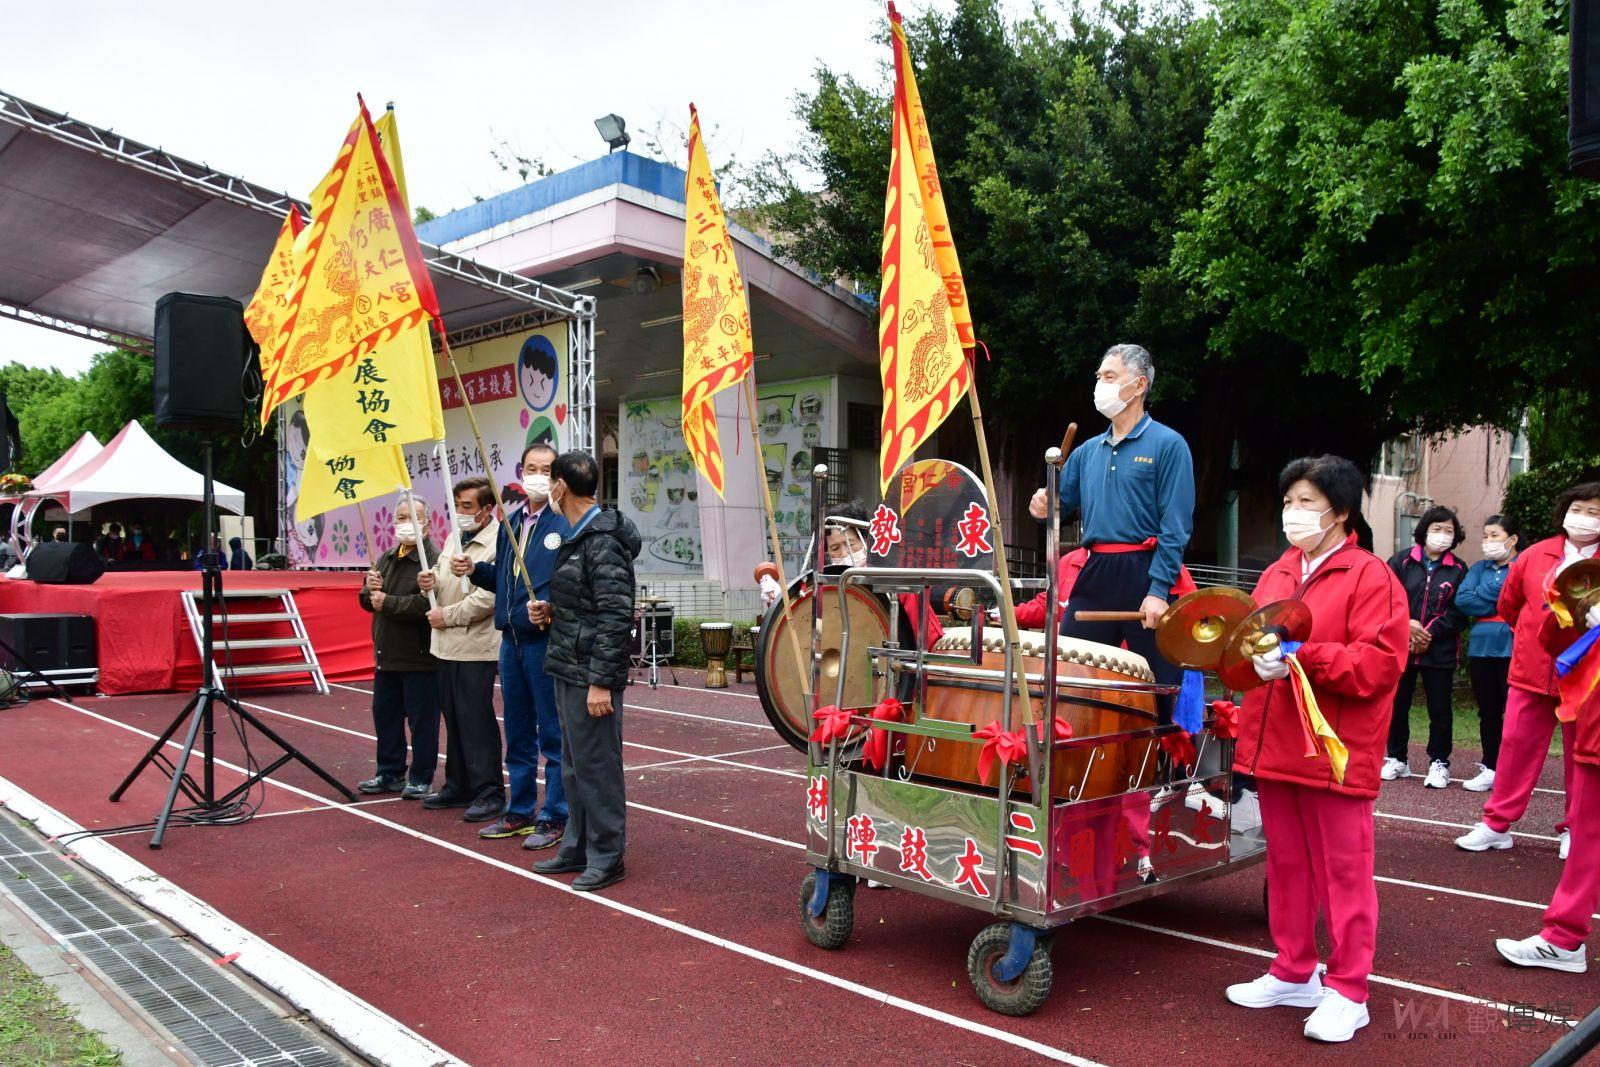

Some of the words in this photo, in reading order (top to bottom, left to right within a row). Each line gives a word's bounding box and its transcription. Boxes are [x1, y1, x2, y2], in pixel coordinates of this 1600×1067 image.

[368, 207, 411, 303] 廣仁宮
[353, 358, 397, 443] 展協會
[325, 454, 365, 500] 協會
[870, 504, 902, 557] 勢
[956, 502, 993, 557] 東
[1005, 811, 1044, 859] 二
